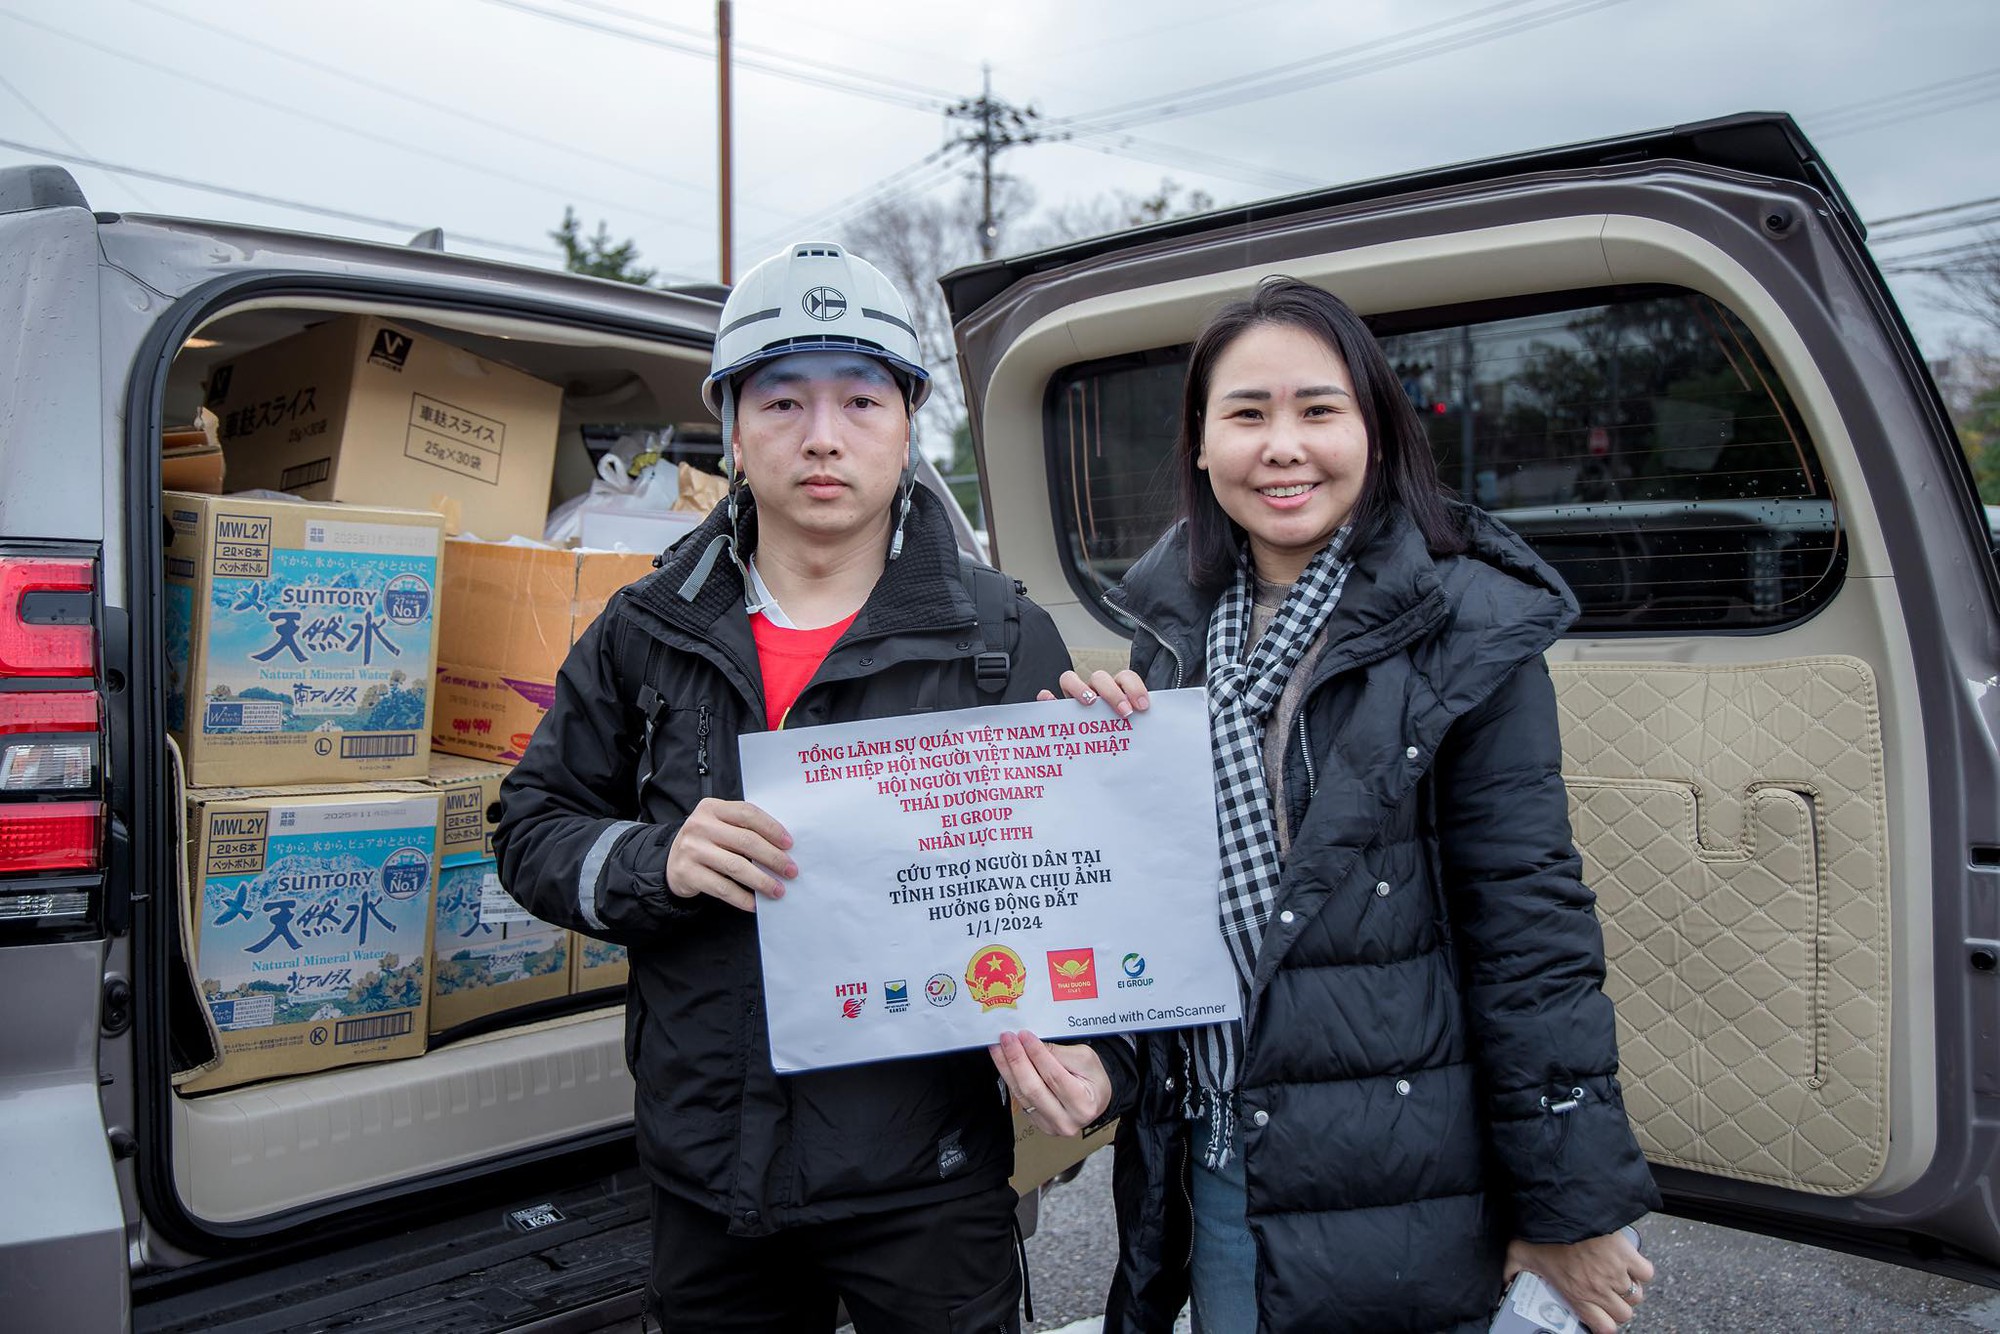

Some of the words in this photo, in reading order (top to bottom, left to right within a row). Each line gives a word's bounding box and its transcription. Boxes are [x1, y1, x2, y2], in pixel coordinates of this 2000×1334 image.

[219, 521, 267, 540] MWL2Y
[219, 562, 263, 573] ペットボトル
[283, 588, 377, 607] SUNTORY
[392, 605, 420, 618] No.1
[250, 610, 400, 666] 天然水
[259, 669, 306, 681] Natural
[310, 669, 356, 680] Mineral
[357, 669, 391, 680] Water
[798, 743, 844, 763] TỔNG
[848, 740, 891, 759] LÃNH
[895, 736, 916, 755] SỰ
[919, 729, 964, 750] QUÁN
[966, 725, 1004, 746] VIỆT
[1007, 725, 1045, 740] NAM
[1048, 722, 1075, 740] TẠI
[1078, 717, 1133, 734] OSAKA
[804, 764, 843, 783] LIÊN
[846, 759, 884, 780] HIỆP
[887, 756, 917, 776] HỘI
[919, 748, 971, 770] NGƯỜI
[971, 745, 1009, 765] VIỆT
[1013, 745, 1050, 759] NAM
[1054, 742, 1081, 760] TẠI
[1084, 735, 1130, 756] NHẬT
[878, 776, 907, 797] HỘI
[910, 770, 962, 790] NGƯỜI
[964, 765, 1000, 786] VIỆT
[1003, 764, 1063, 780] KANSAI
[447, 792, 480, 810] MWL2Y
[900, 793, 940, 813] THÁI
[943, 785, 1045, 807] DƯƠNGMART
[213, 818, 264, 836] MWL2Y
[941, 814, 958, 829] EI
[960, 807, 1013, 826] GROUP
[918, 831, 965, 851] NHÂN
[968, 827, 998, 847] LỰC
[1000, 826, 1033, 841] HTH
[213, 858, 258, 870] ペットボトル
[897, 863, 931, 883] CỨU
[936, 860, 971, 880] TRỢ
[975, 851, 1028, 872] NGƯỜI
[1032, 849, 1068, 868] DÂN
[1071, 849, 1101, 868] TẠI
[278, 871, 375, 892] SUNTORY
[390, 877, 419, 892] No.1
[889, 884, 935, 904] TỈNH
[939, 876, 1026, 899] ISHIKAWA
[1030, 872, 1071, 891] CHỊU
[1074, 866, 1112, 885] ẢNH
[928, 898, 990, 920] HƯỞNG
[994, 893, 1041, 914] ĐỘNG
[1044, 887, 1079, 908] ĐẤT
[244, 891, 397, 953] 天然水
[966, 915, 1043, 938] 1/1/2024
[252, 955, 300, 972] Natural
[304, 952, 350, 967] Mineral
[353, 950, 387, 961] Water
[835, 982, 868, 997] HTH
[1117, 979, 1125, 988] EI
[1127, 978, 1154, 988] GROUP
[1068, 1012, 1116, 1027] Scanned
[1119, 1010, 1145, 1023] with
[1147, 1003, 1226, 1020] CamScanner
